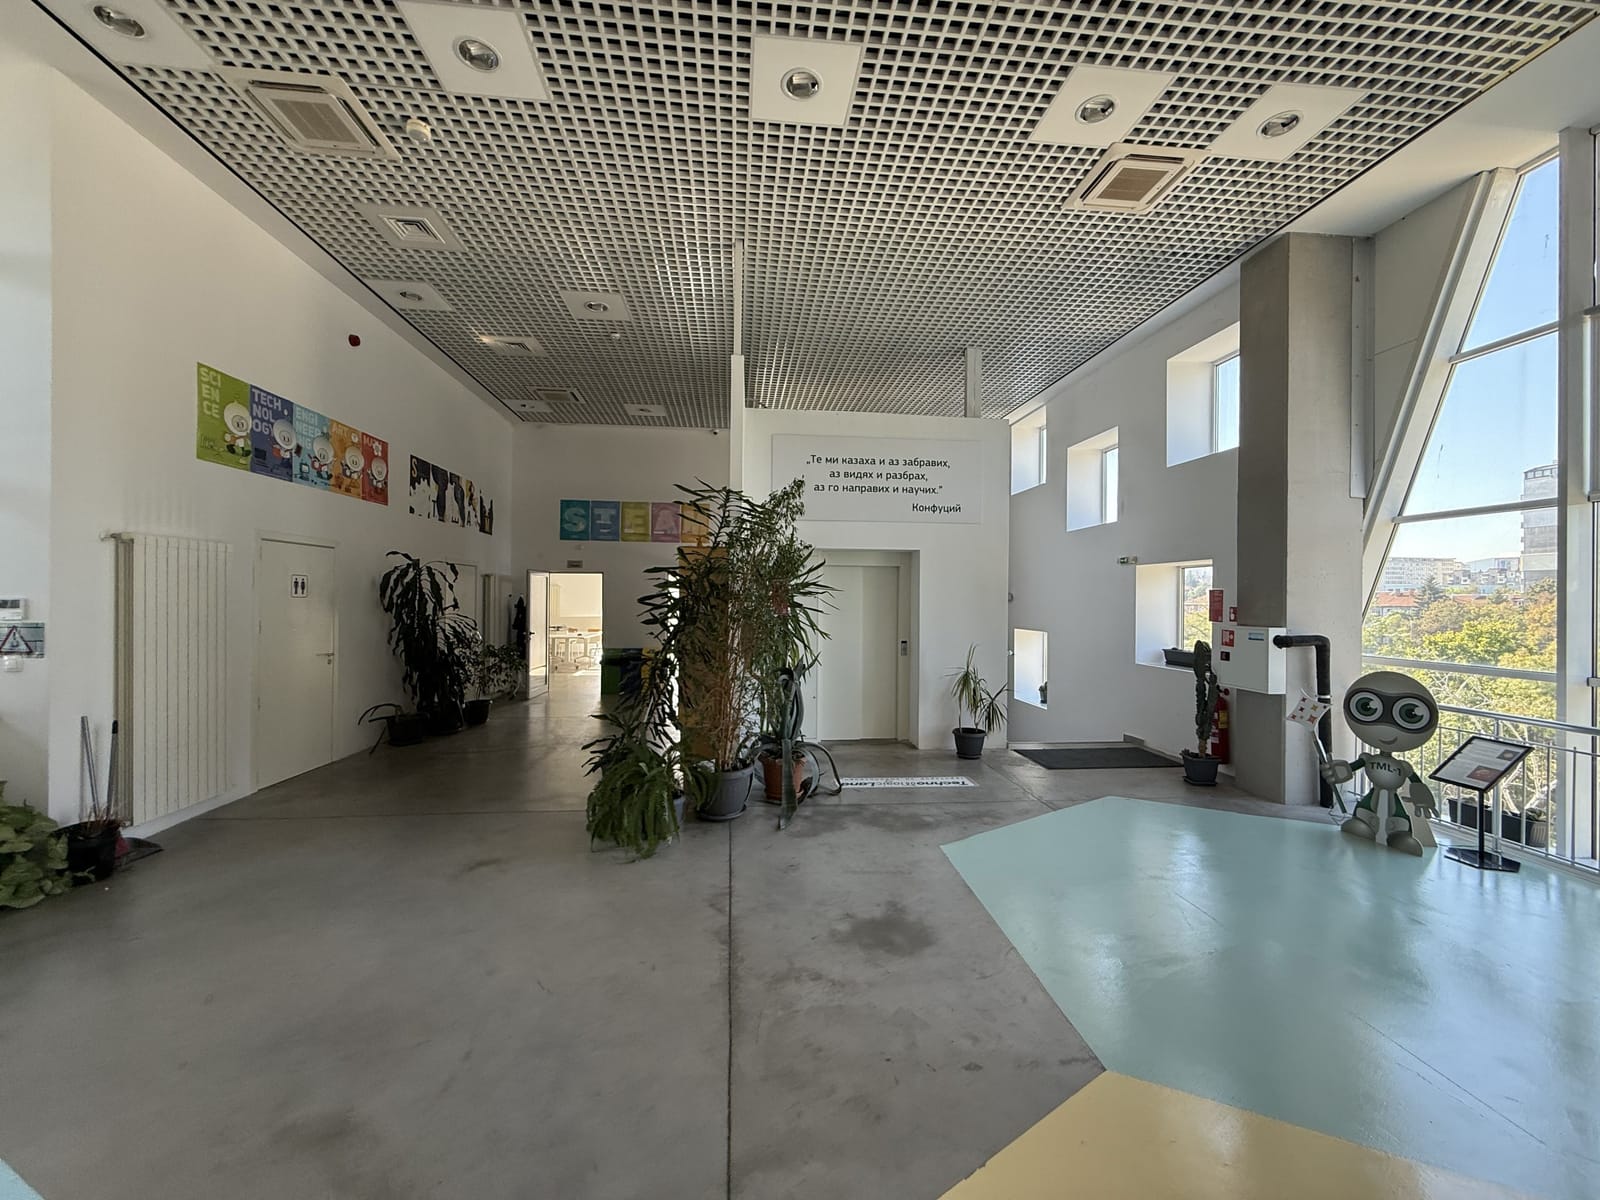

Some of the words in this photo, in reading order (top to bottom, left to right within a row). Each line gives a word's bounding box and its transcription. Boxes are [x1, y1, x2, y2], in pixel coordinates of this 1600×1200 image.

[200, 367, 221, 388] SCI
[201, 383, 220, 402] EN
[252, 388, 281, 411] TECH
[203, 401, 220, 418] CE
[252, 404, 275, 422] NOL
[841, 457, 876, 465] казаха
[902, 456, 950, 468] забравих,
[843, 471, 873, 480] видях
[886, 471, 928, 482] разбрах,
[842, 485, 889, 495] направих
[912, 502, 961, 514] Конфуций
[1369, 761, 1401, 776] TML-1
